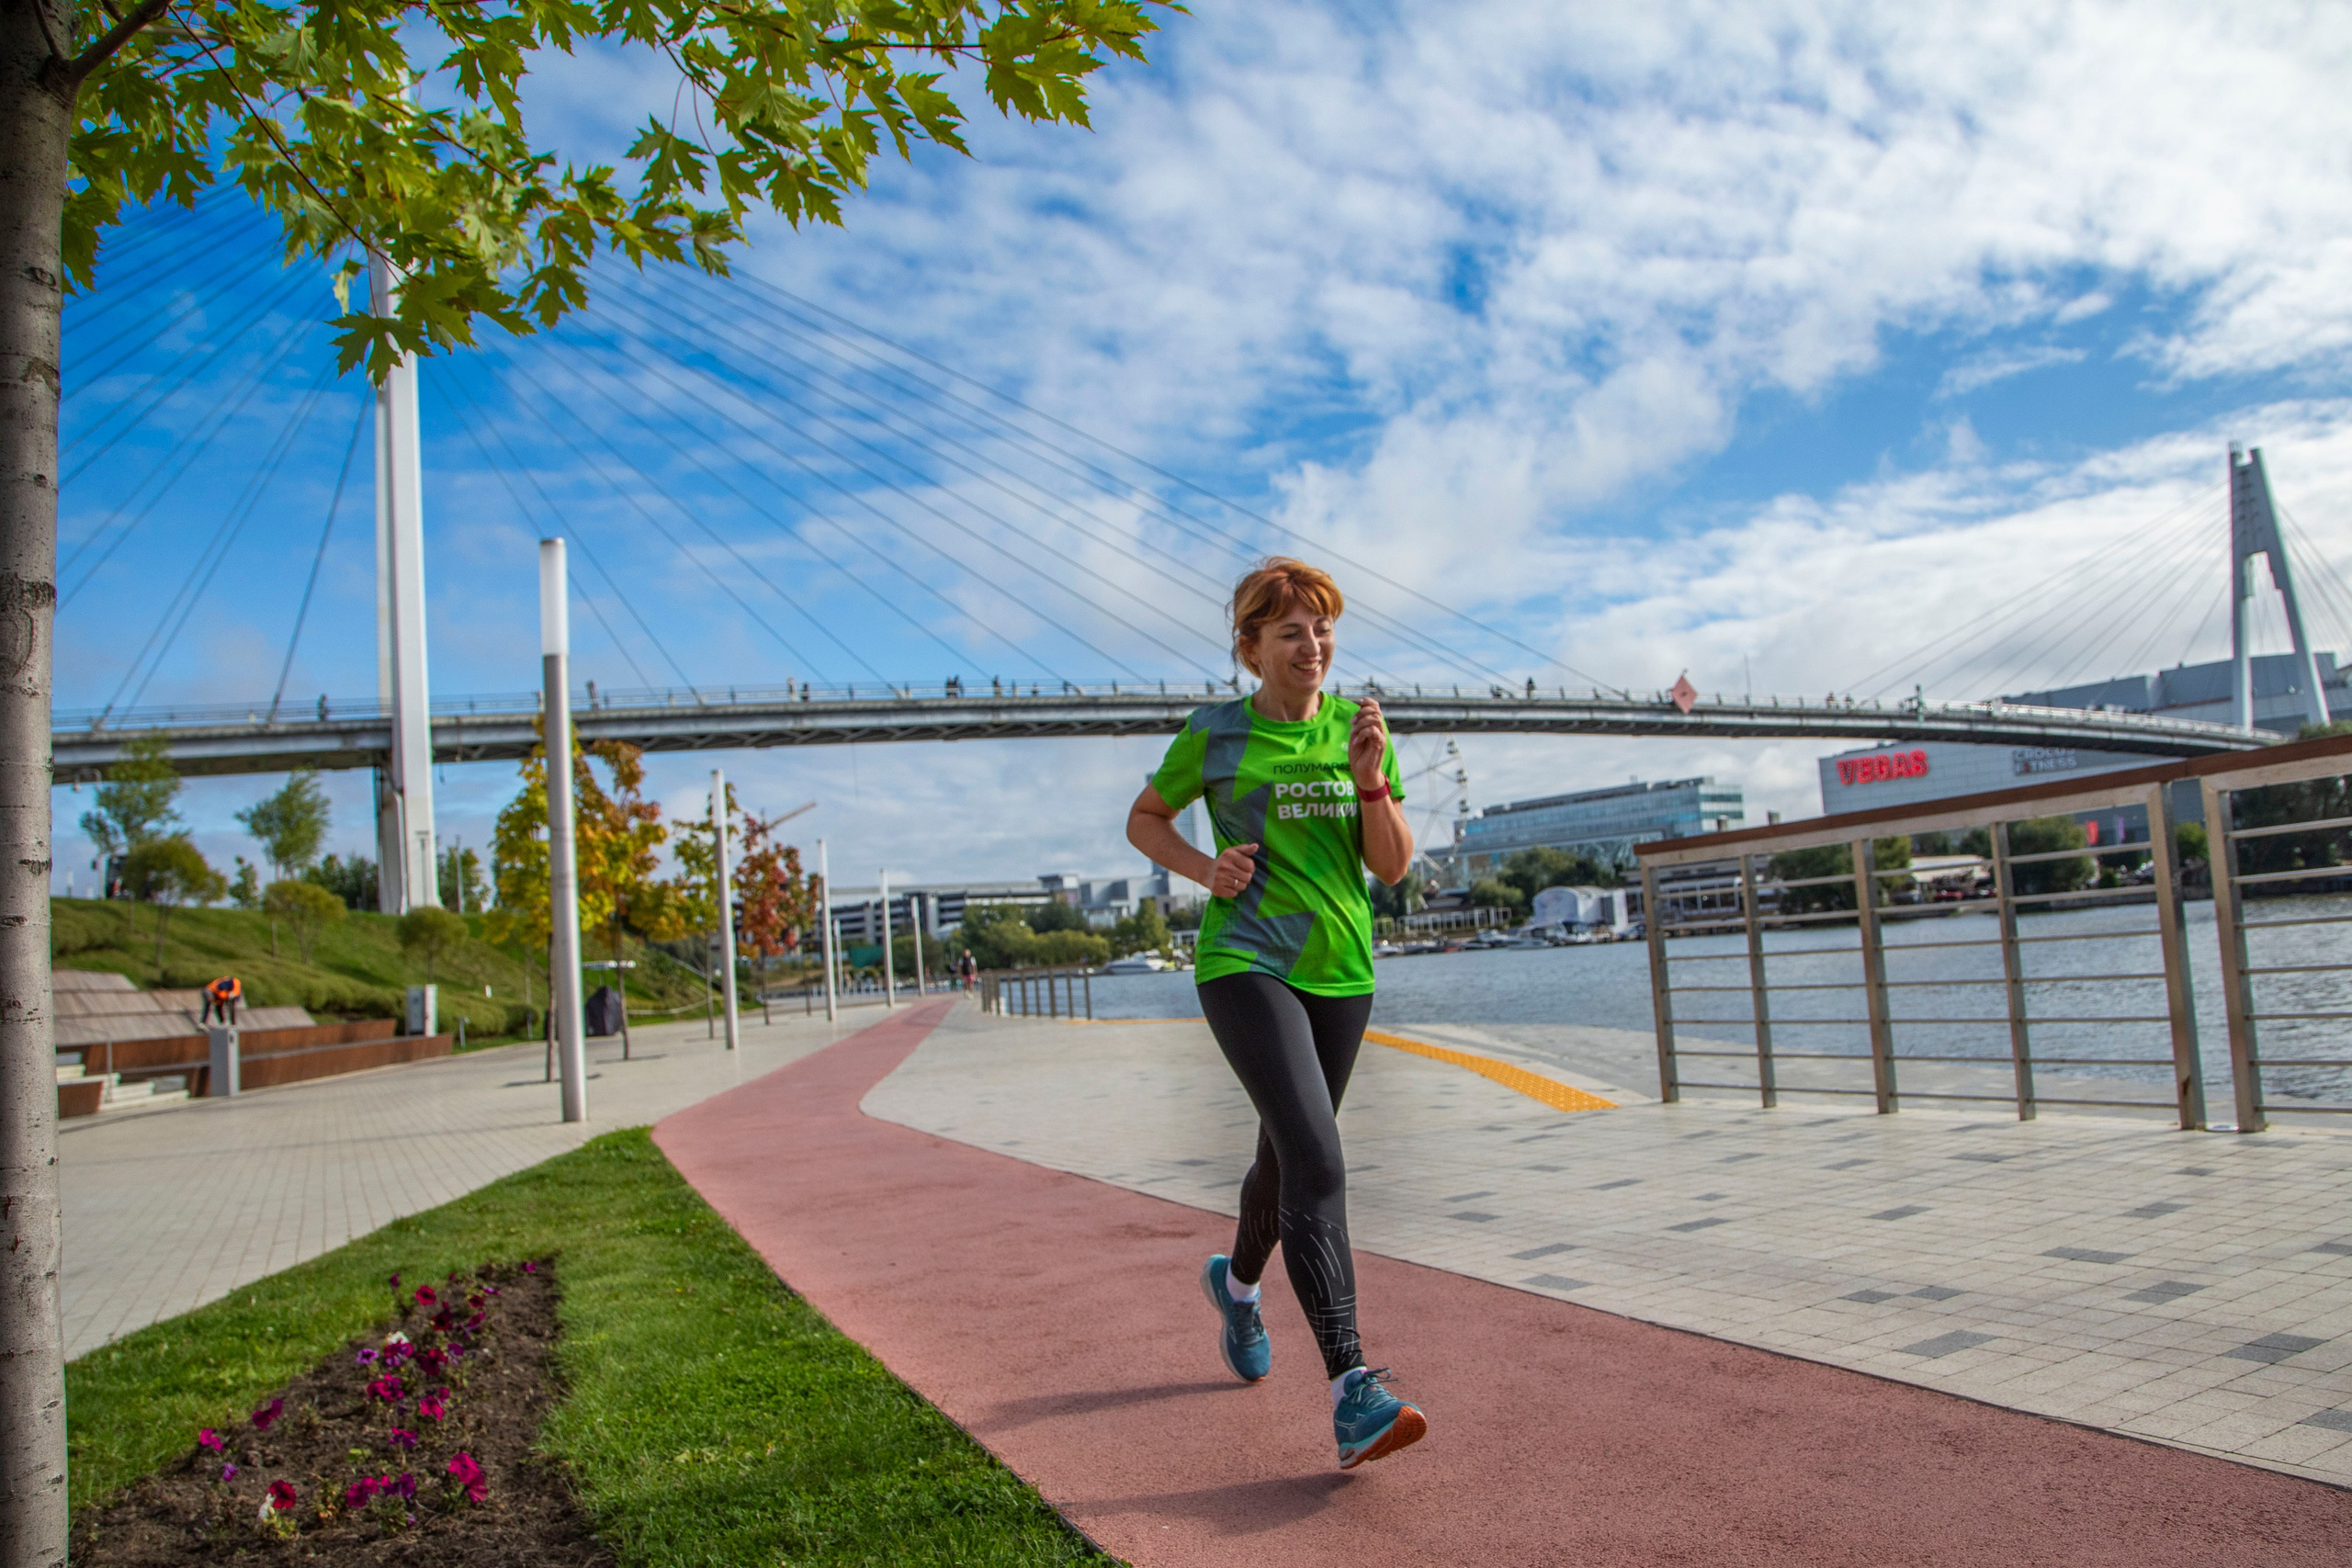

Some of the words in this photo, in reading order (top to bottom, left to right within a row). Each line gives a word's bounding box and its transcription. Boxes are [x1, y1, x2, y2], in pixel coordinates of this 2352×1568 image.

[1836, 749, 1928, 785] VEGAS
[1274, 780, 1355, 799] РОСТОВ
[1277, 801, 1358, 819] ВЕЛИКИ
